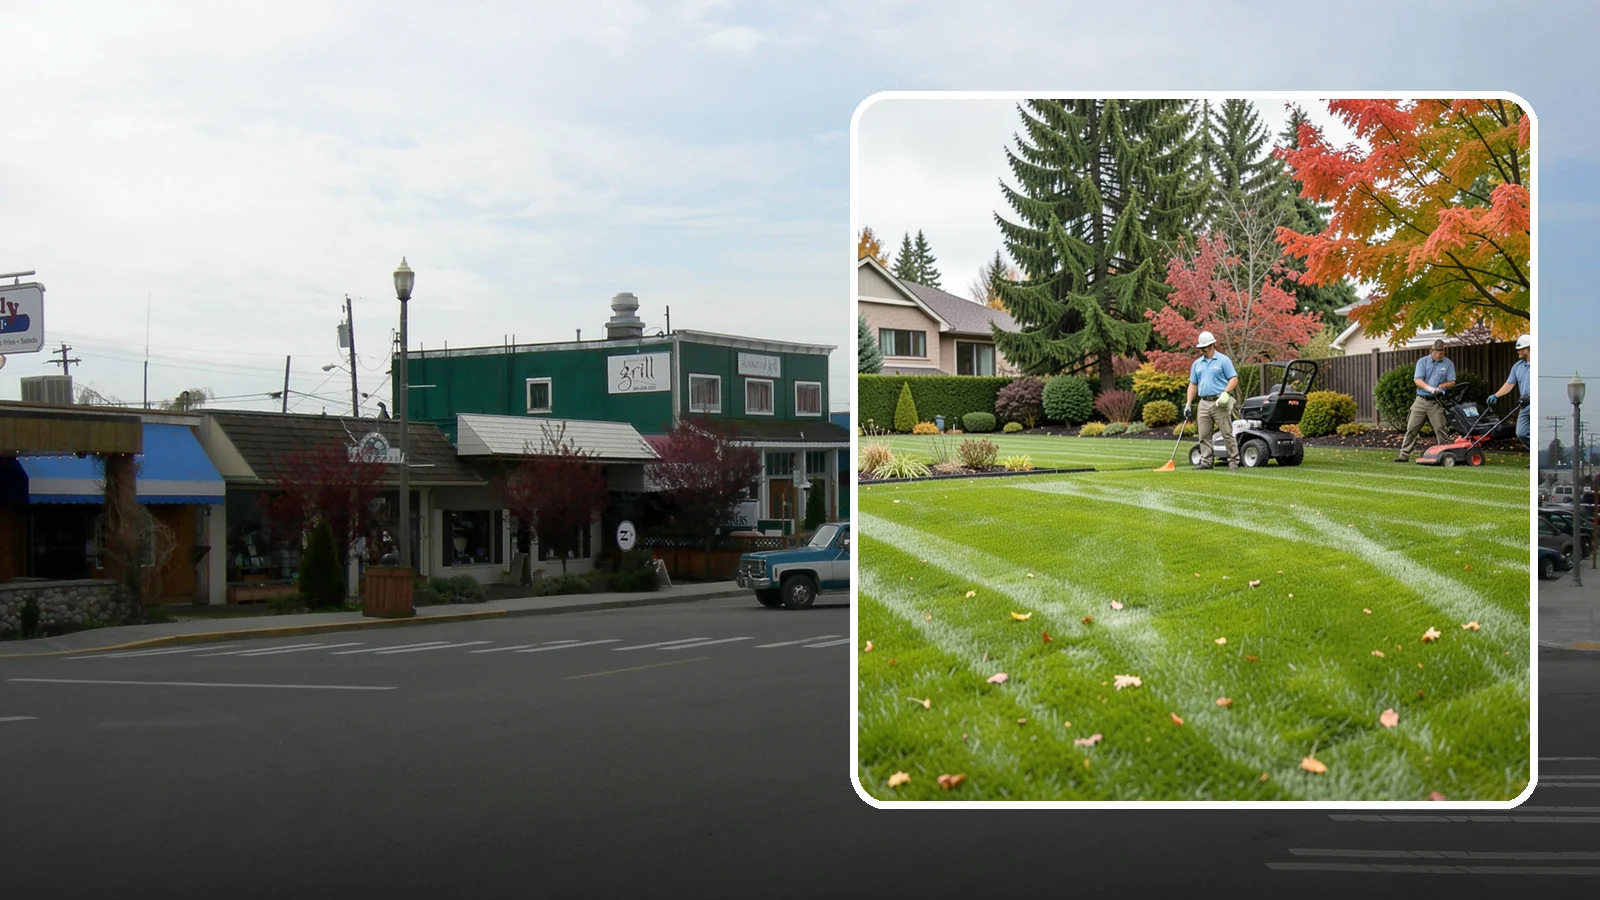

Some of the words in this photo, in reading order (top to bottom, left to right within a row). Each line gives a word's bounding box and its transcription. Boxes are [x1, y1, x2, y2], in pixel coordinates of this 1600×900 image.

[3, 338, 16, 346] Fries
[20, 336, 38, 344] Salads
[618, 356, 655, 391] grill
